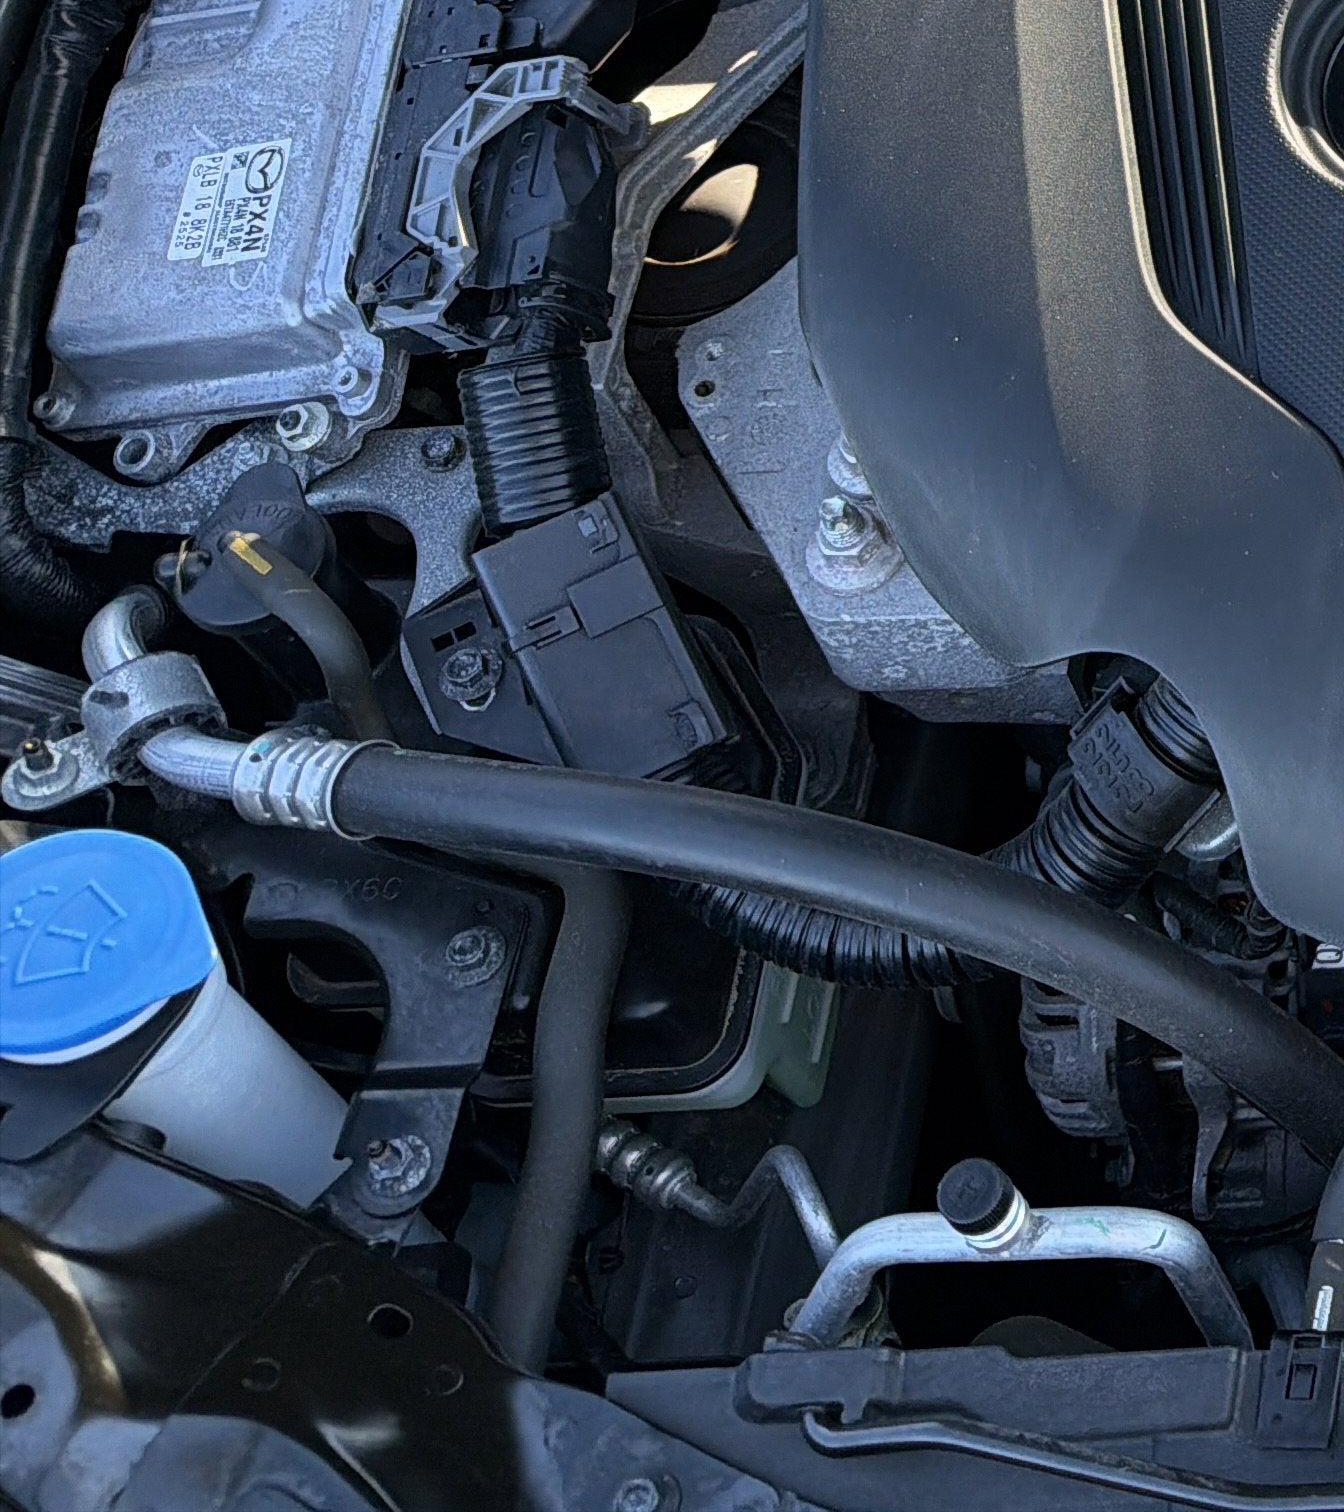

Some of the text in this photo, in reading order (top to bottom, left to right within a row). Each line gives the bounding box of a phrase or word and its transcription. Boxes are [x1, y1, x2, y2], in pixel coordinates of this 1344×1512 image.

[200, 155, 224, 189] PXLB
[194, 195, 213, 211] 18
[184, 218, 208, 252] 8K2B
[240, 194, 273, 254] PX4N
